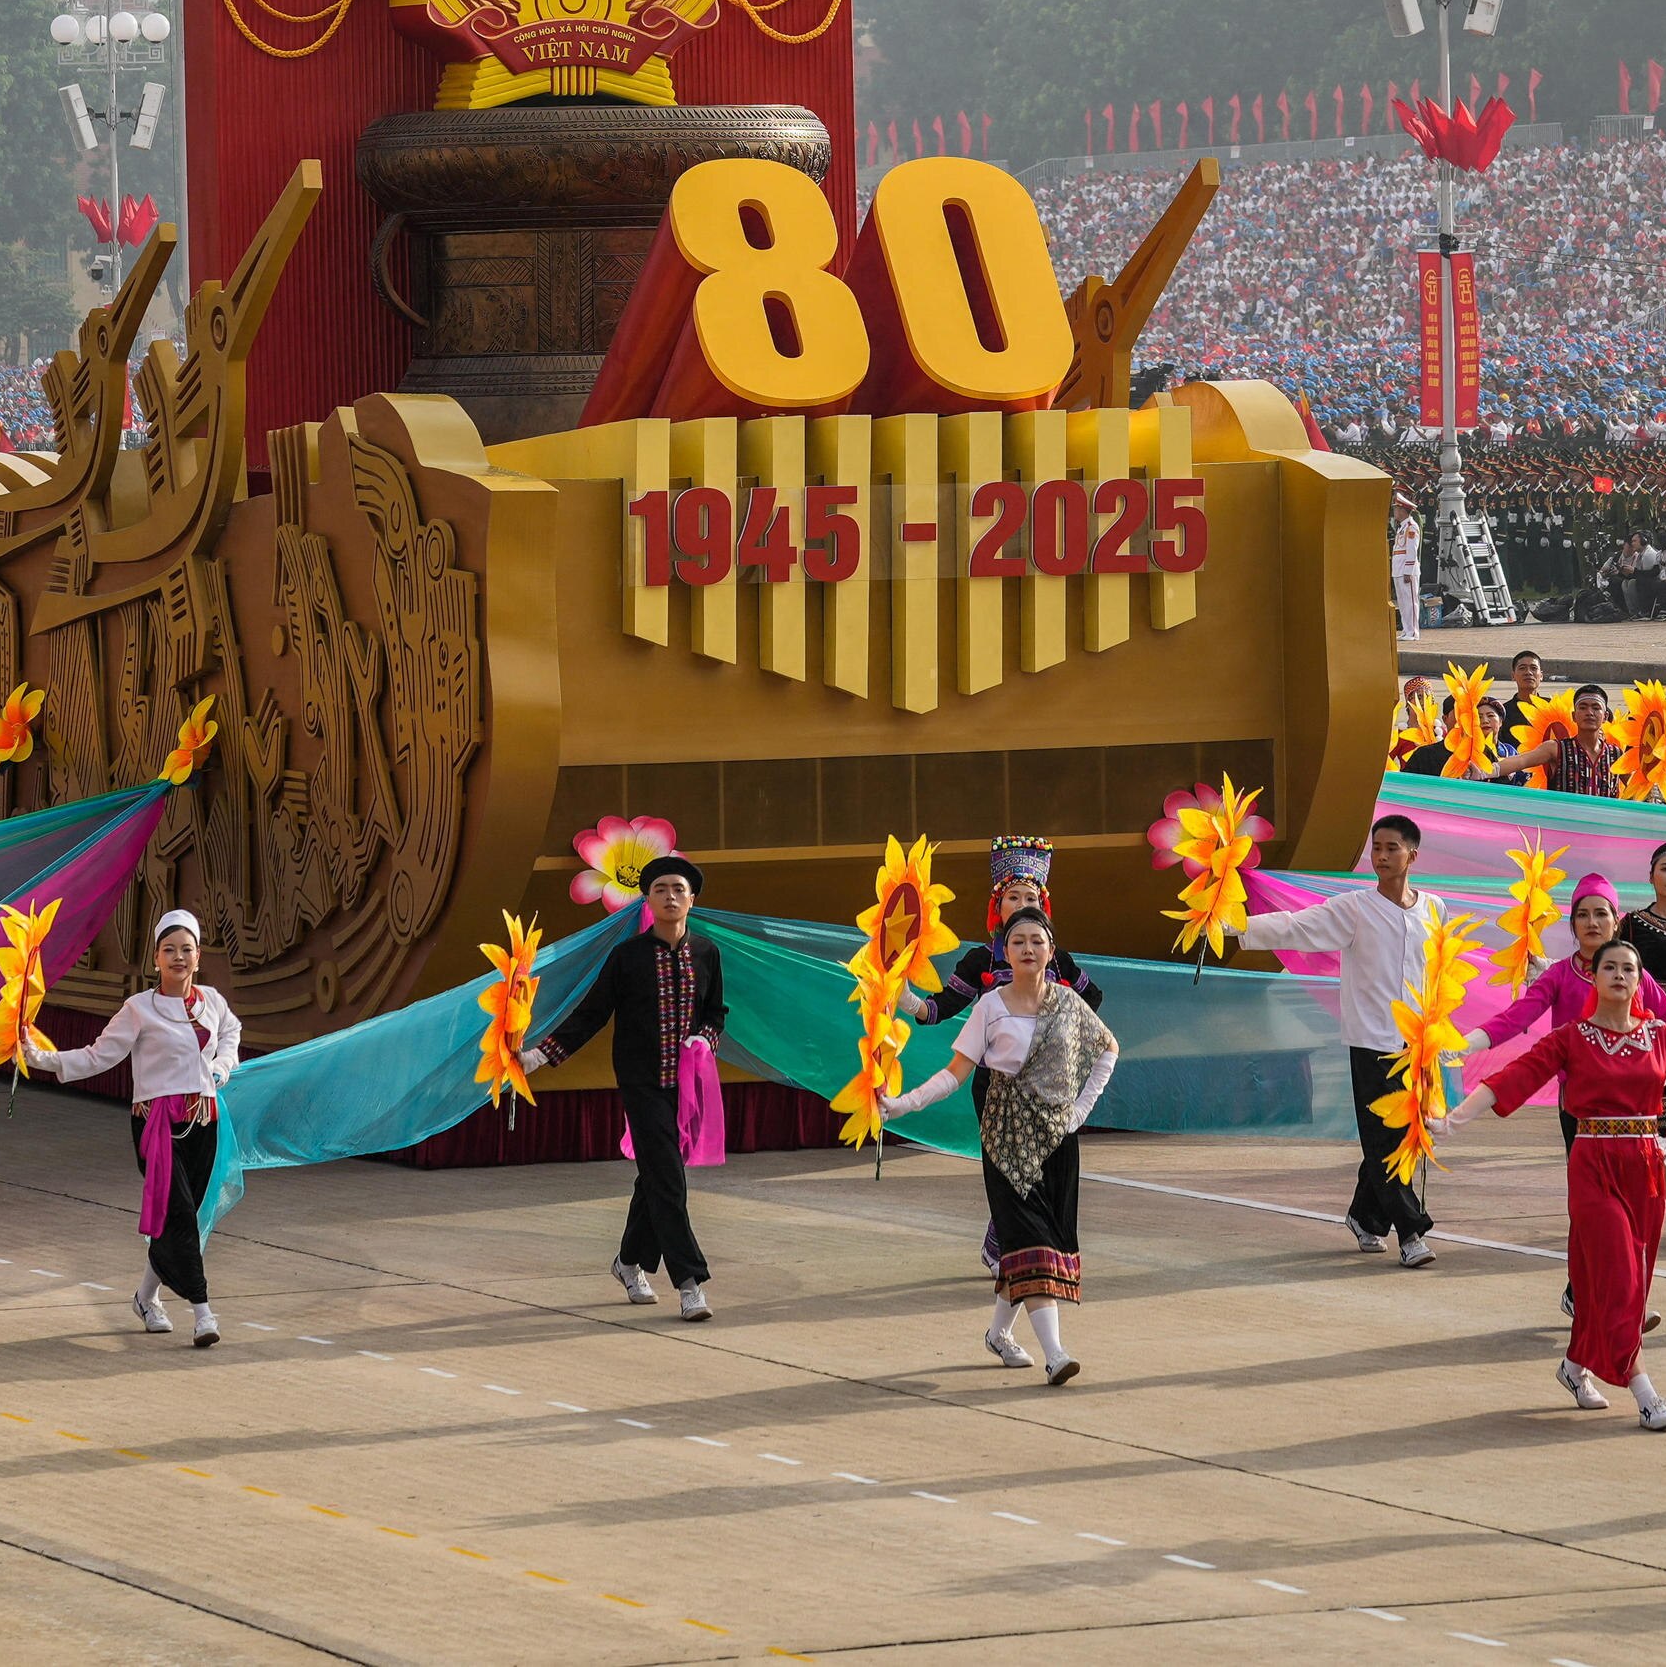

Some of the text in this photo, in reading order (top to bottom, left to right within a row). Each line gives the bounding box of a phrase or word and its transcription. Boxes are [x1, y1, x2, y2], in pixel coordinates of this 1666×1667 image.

[514, 31, 537, 44] CỘNG
[559, 25, 572, 33] XÃ
[575, 25, 589, 33] HỘI
[592, 25, 609, 35] CHỦ
[611, 29, 636, 43] NGHĨA
[521, 38, 633, 64] VIỆT NAM
[671, 156, 1075, 406] 80
[629, 478, 1208, 586] 1945 - 2025
